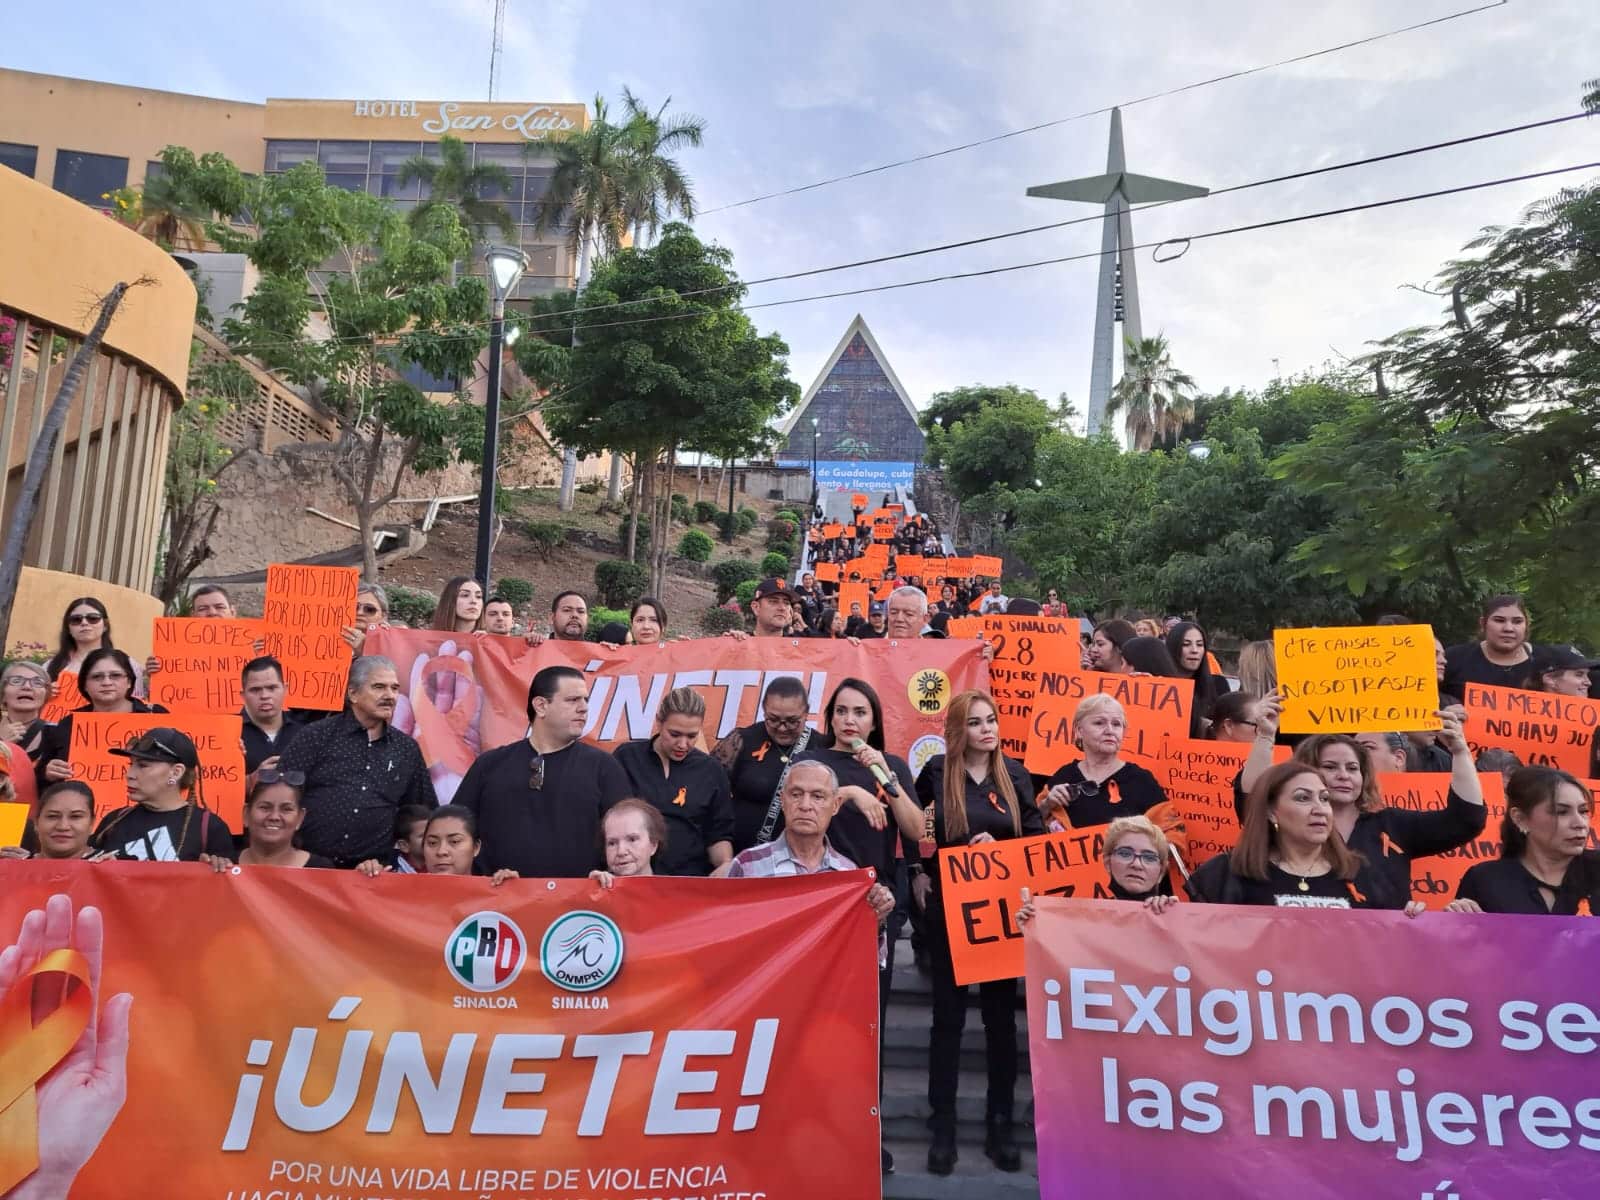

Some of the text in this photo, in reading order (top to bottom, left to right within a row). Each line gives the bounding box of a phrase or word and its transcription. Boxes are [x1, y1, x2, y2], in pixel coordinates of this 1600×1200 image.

[353, 101, 576, 140] HOTEL San Luis
[818, 468, 830, 477] de
[832, 468, 888, 479] Guadalupe,
[269, 567, 291, 595] POR
[322, 570, 359, 602] HIJAS
[266, 601, 289, 625] POR
[156, 621, 255, 648] NI GOLPES
[984, 619, 1003, 631] EN
[1008, 620, 1068, 635] SINALOA
[264, 632, 284, 658] POR
[314, 634, 344, 661] QUE
[1392, 635, 1415, 648] DE
[217, 656, 230, 672] NI
[160, 684, 198, 705] QUE
[919, 699, 940, 711] PRD
[1040, 671, 1182, 718] NOS FALTA
[1468, 687, 1497, 711] EN
[75, 720, 98, 750] NI
[1485, 719, 1512, 738] NO
[1518, 721, 1559, 745] HAY
[947, 850, 1010, 884] NOS
[455, 927, 514, 969] PRI
[556, 968, 605, 985] ONMPRI
[453, 996, 609, 1010] SINALOA SINALOA
[1044, 966, 1473, 1056] ¡Exigimos
[222, 996, 780, 1151] ¡ÚNETE!
[1102, 1057, 1600, 1162] las mujeres
[269, 1160, 728, 1192] POR UNA VIDA LIBRE DE VIOLENCIA
